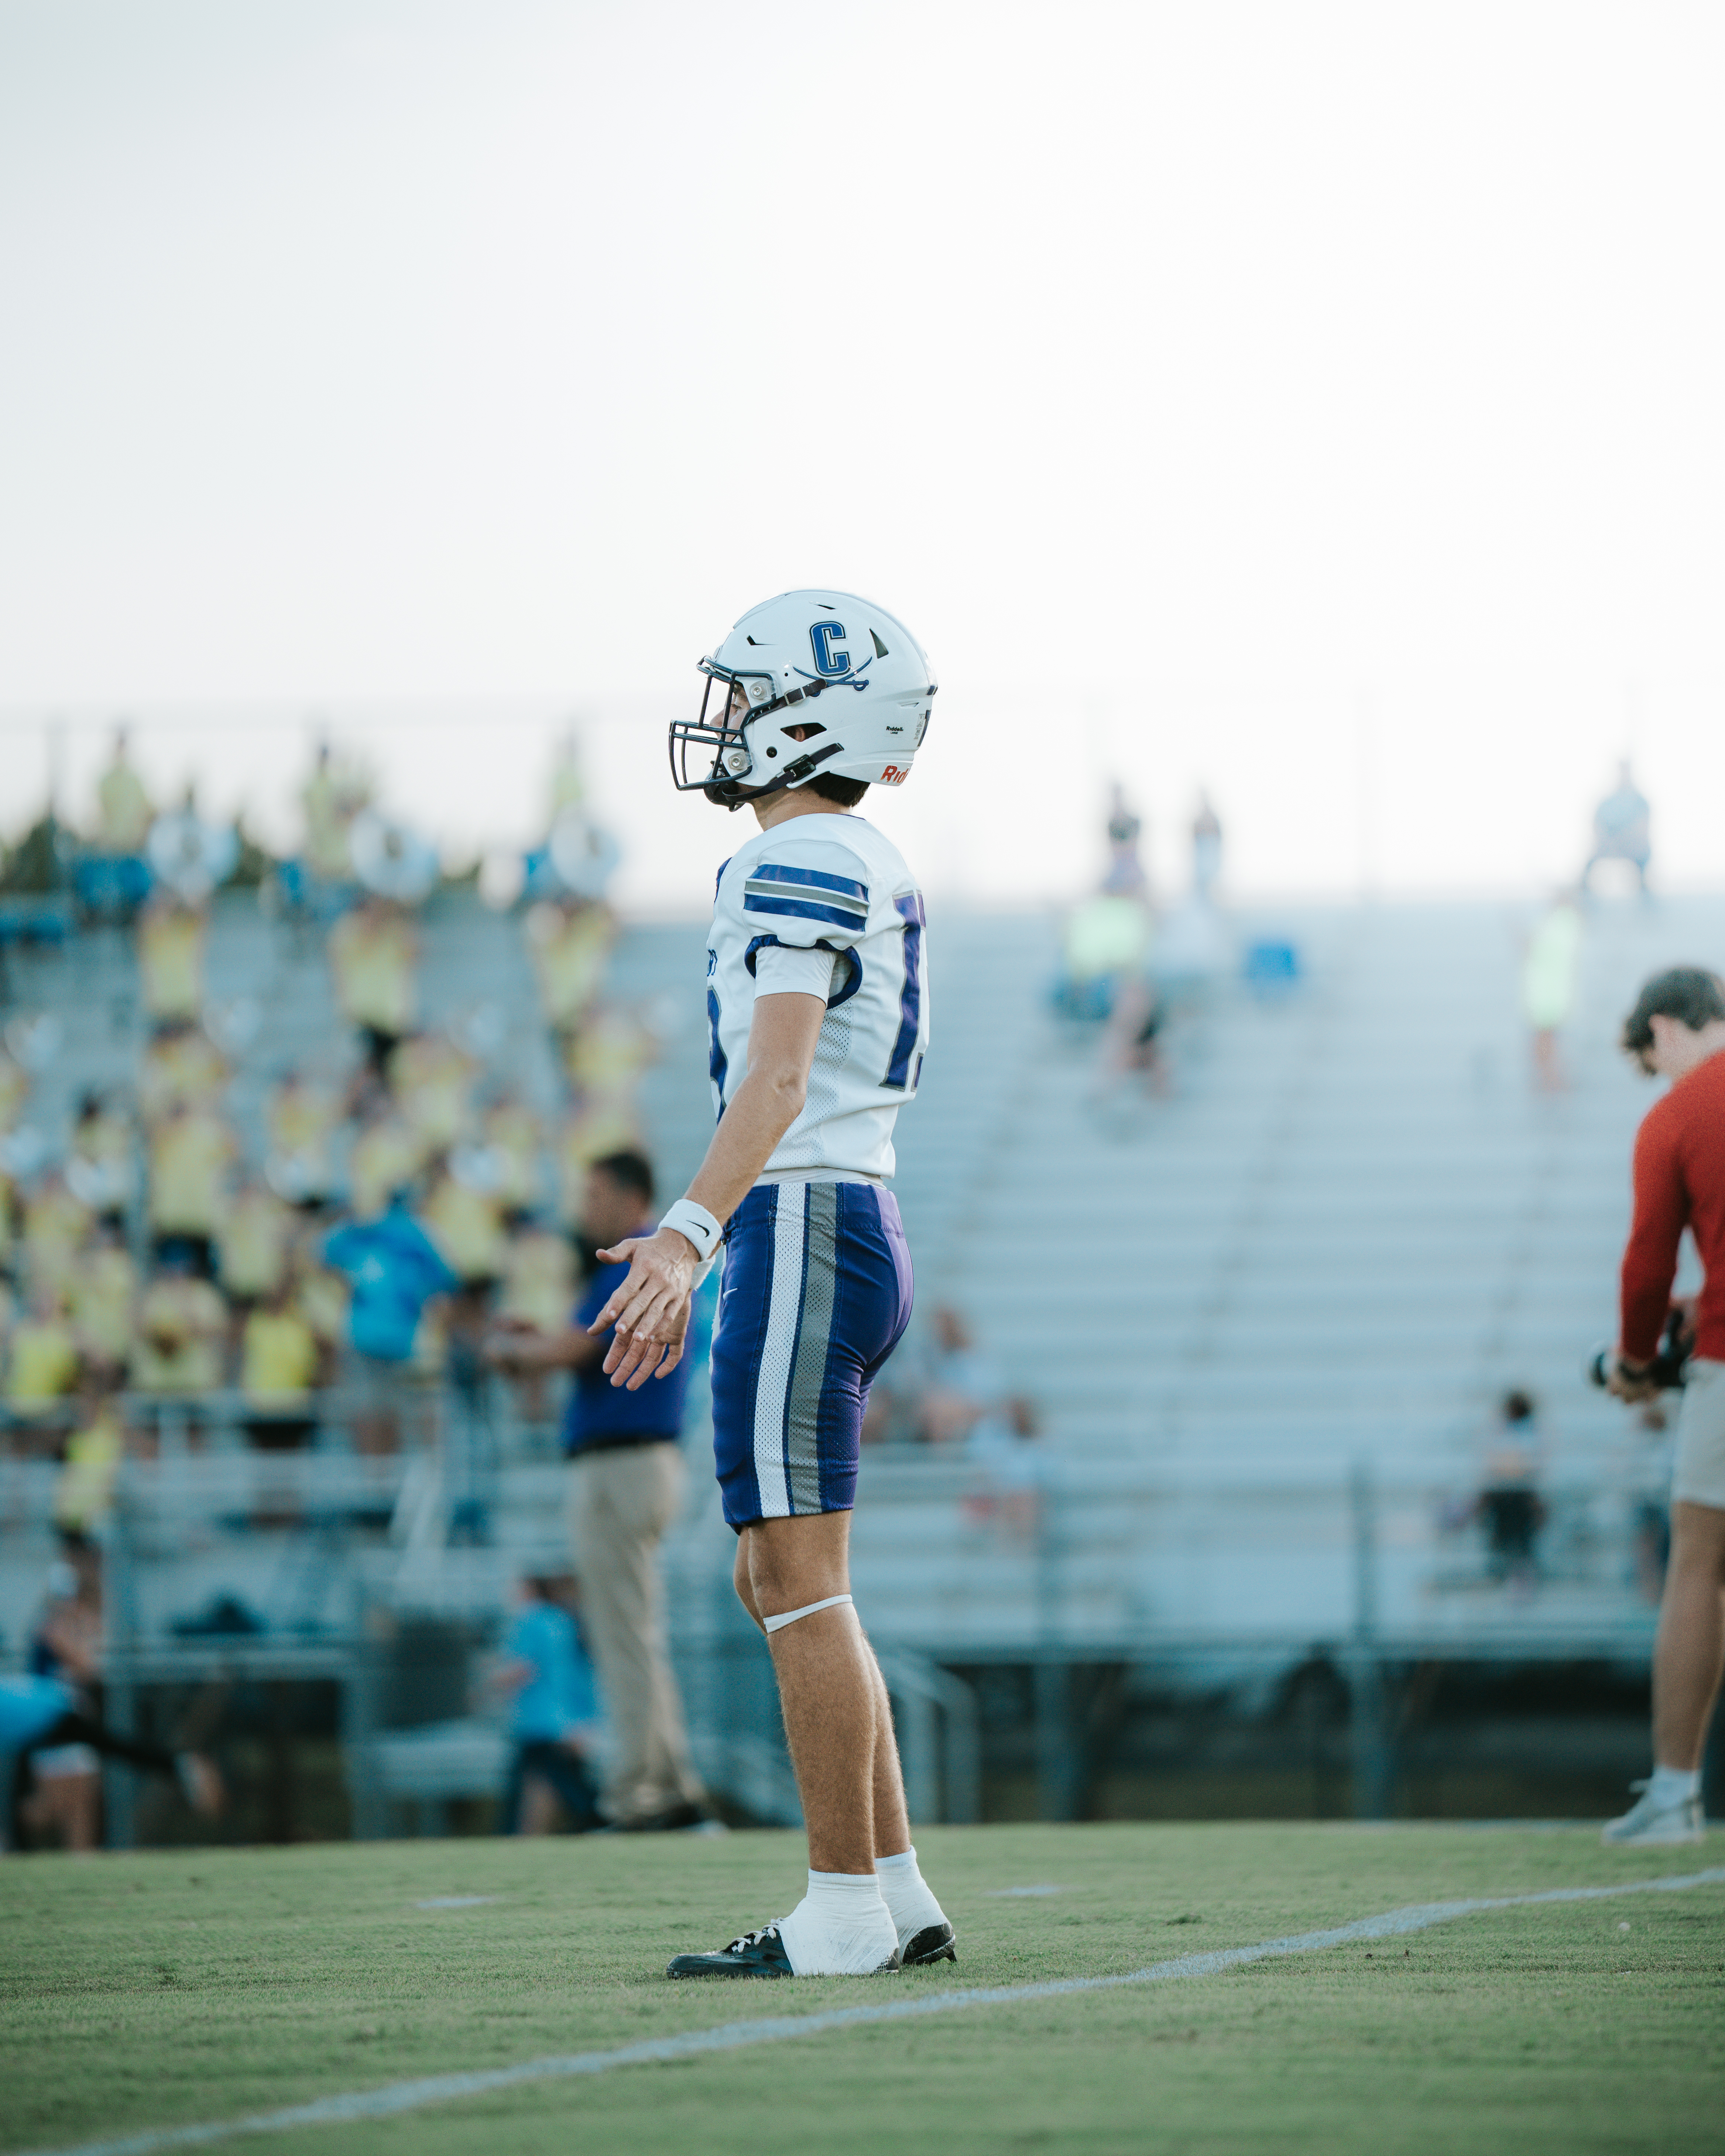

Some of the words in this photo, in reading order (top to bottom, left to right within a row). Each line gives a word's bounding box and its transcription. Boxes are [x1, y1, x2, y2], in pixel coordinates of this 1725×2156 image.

[809, 621, 851, 677] C
[880, 765, 909, 783] Rid
[878, 889, 930, 1092] 1
